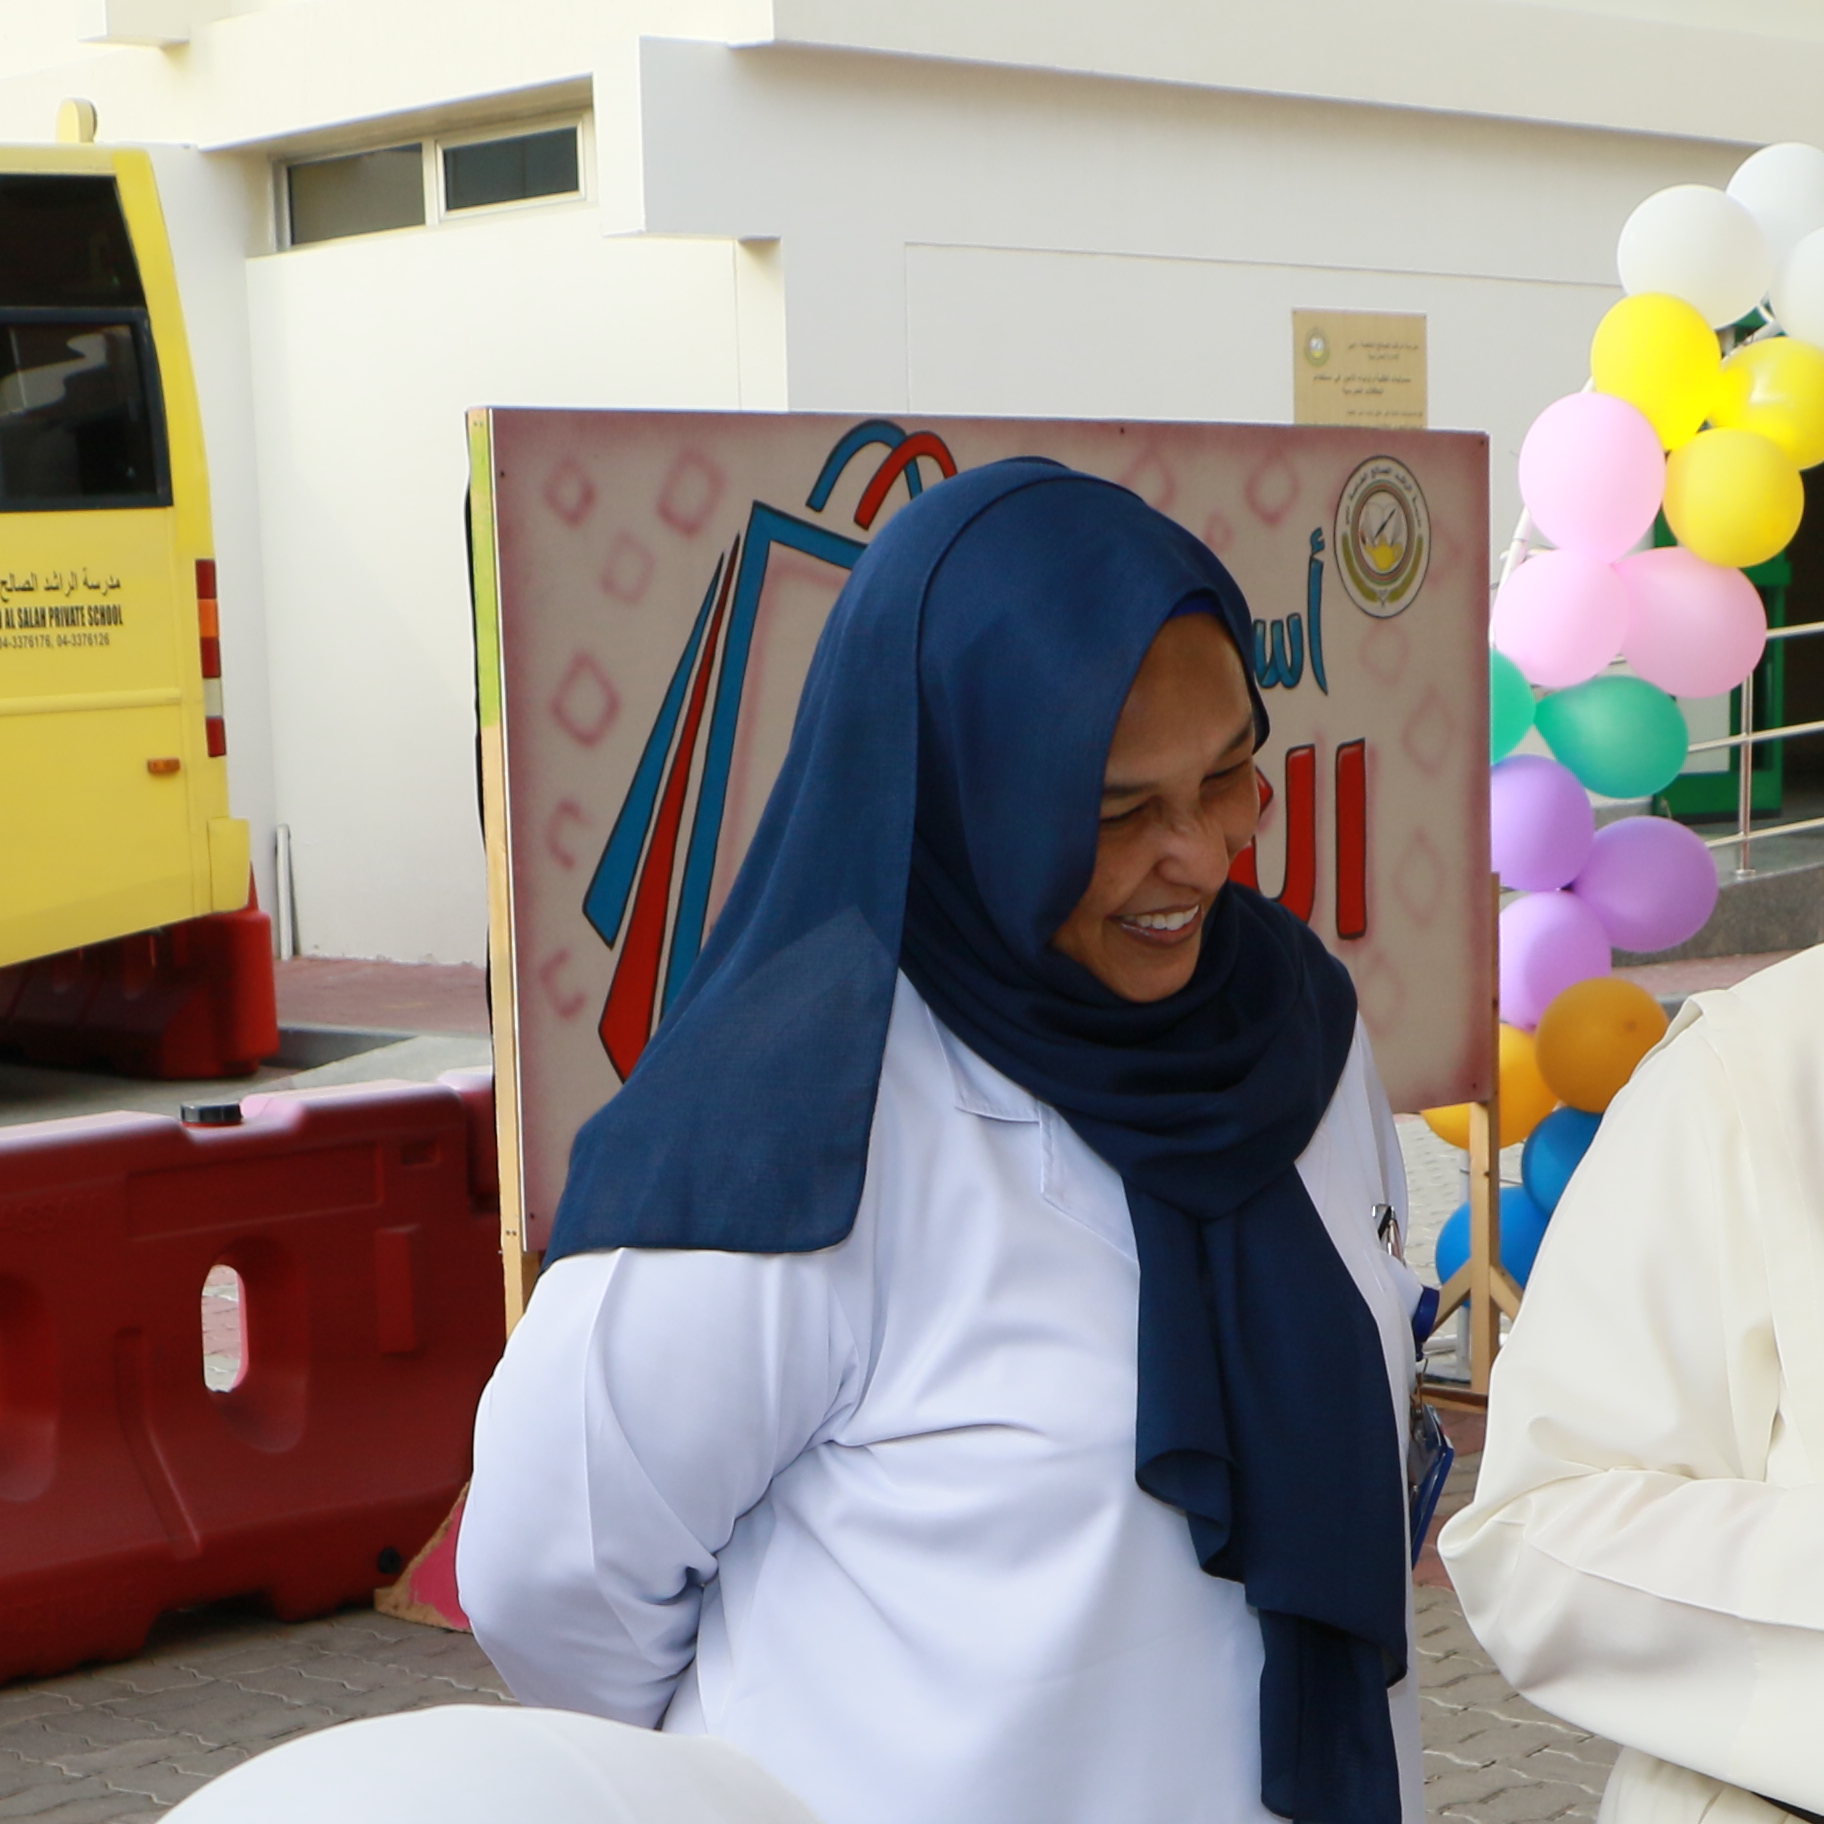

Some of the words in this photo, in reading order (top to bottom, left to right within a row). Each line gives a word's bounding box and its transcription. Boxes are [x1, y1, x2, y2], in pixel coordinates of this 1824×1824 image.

[0, 572, 39, 603] الصالح
[44, 571, 78, 598] الراشد
[82, 567, 121, 596] مدرسة
[5, 607, 16, 629] AL
[48, 605, 86, 627] PRIVATE
[87, 604, 124, 626] SCHOOL
